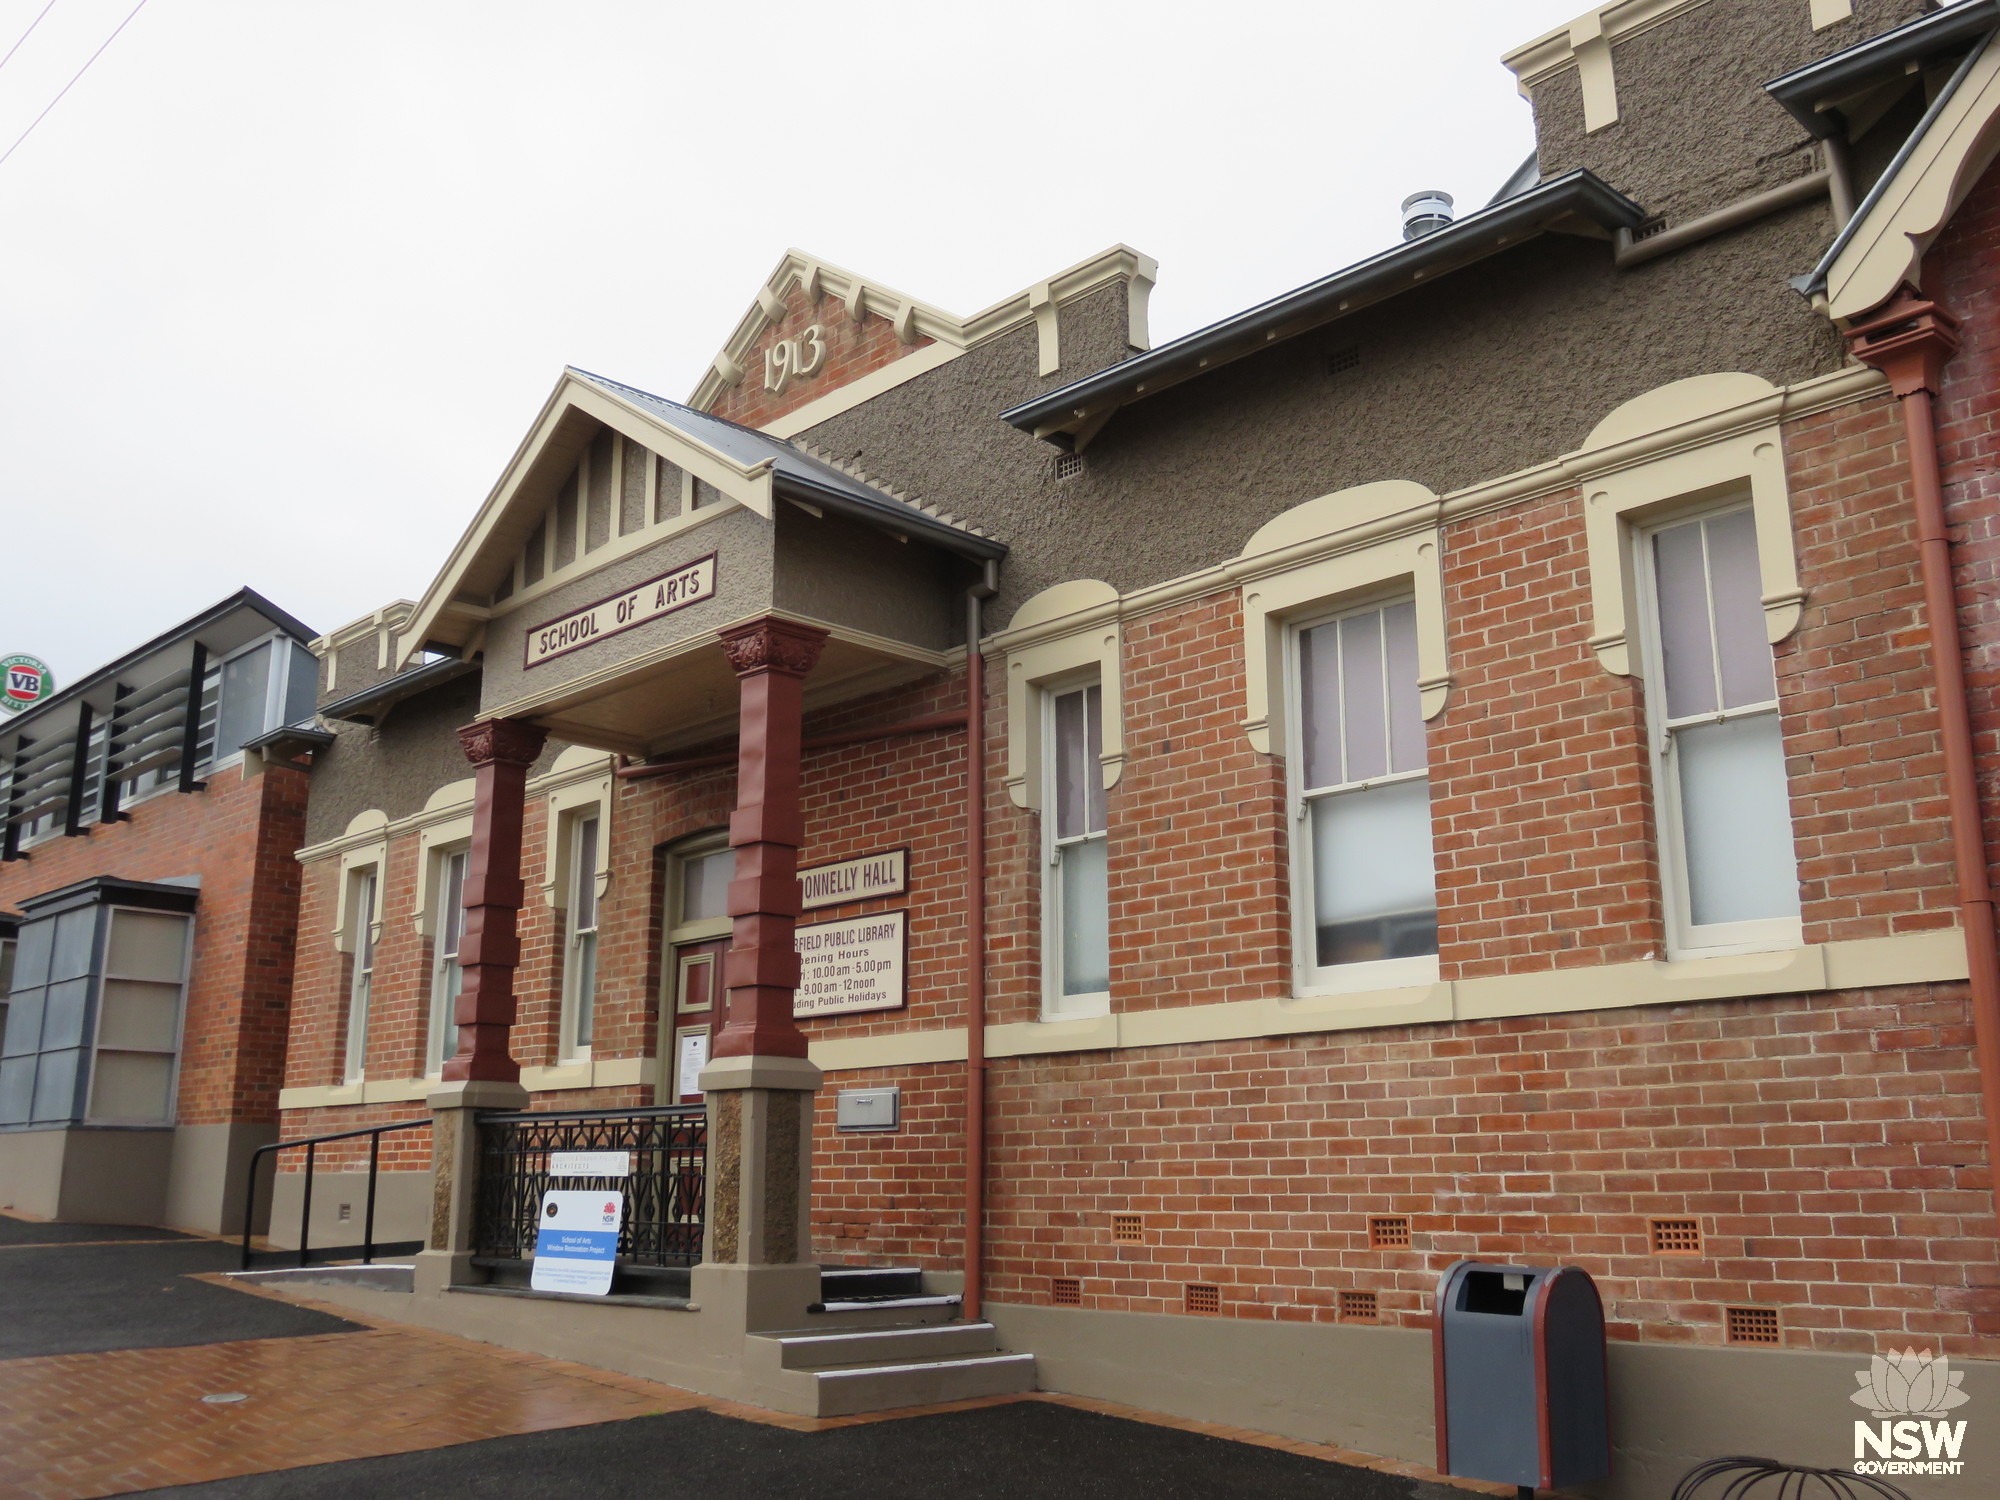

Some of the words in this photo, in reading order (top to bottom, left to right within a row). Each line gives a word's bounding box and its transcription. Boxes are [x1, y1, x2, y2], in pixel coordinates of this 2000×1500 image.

[764, 324, 826, 394] 1913
[539, 612, 599, 654] SCHOOL
[616, 594, 638, 623] OF
[655, 569, 700, 609] ARTS
[1, 656, 47, 675] VICTORIA
[10, 673, 39, 691] VB
[798, 866, 857, 899] ONNELLY
[863, 859, 896, 888] HALL
[824, 929, 855, 948] PUBLIC
[858, 923, 896, 943] LIBRARY
[838, 948, 869, 960] Hours
[818, 994, 844, 1006] Public
[848, 991, 887, 1003] Holidays
[547, 1243, 564, 1251] Window
[588, 1246, 605, 1254] Project
[561, 1236, 576, 1244] School
[582, 1237, 592, 1245] Arts
